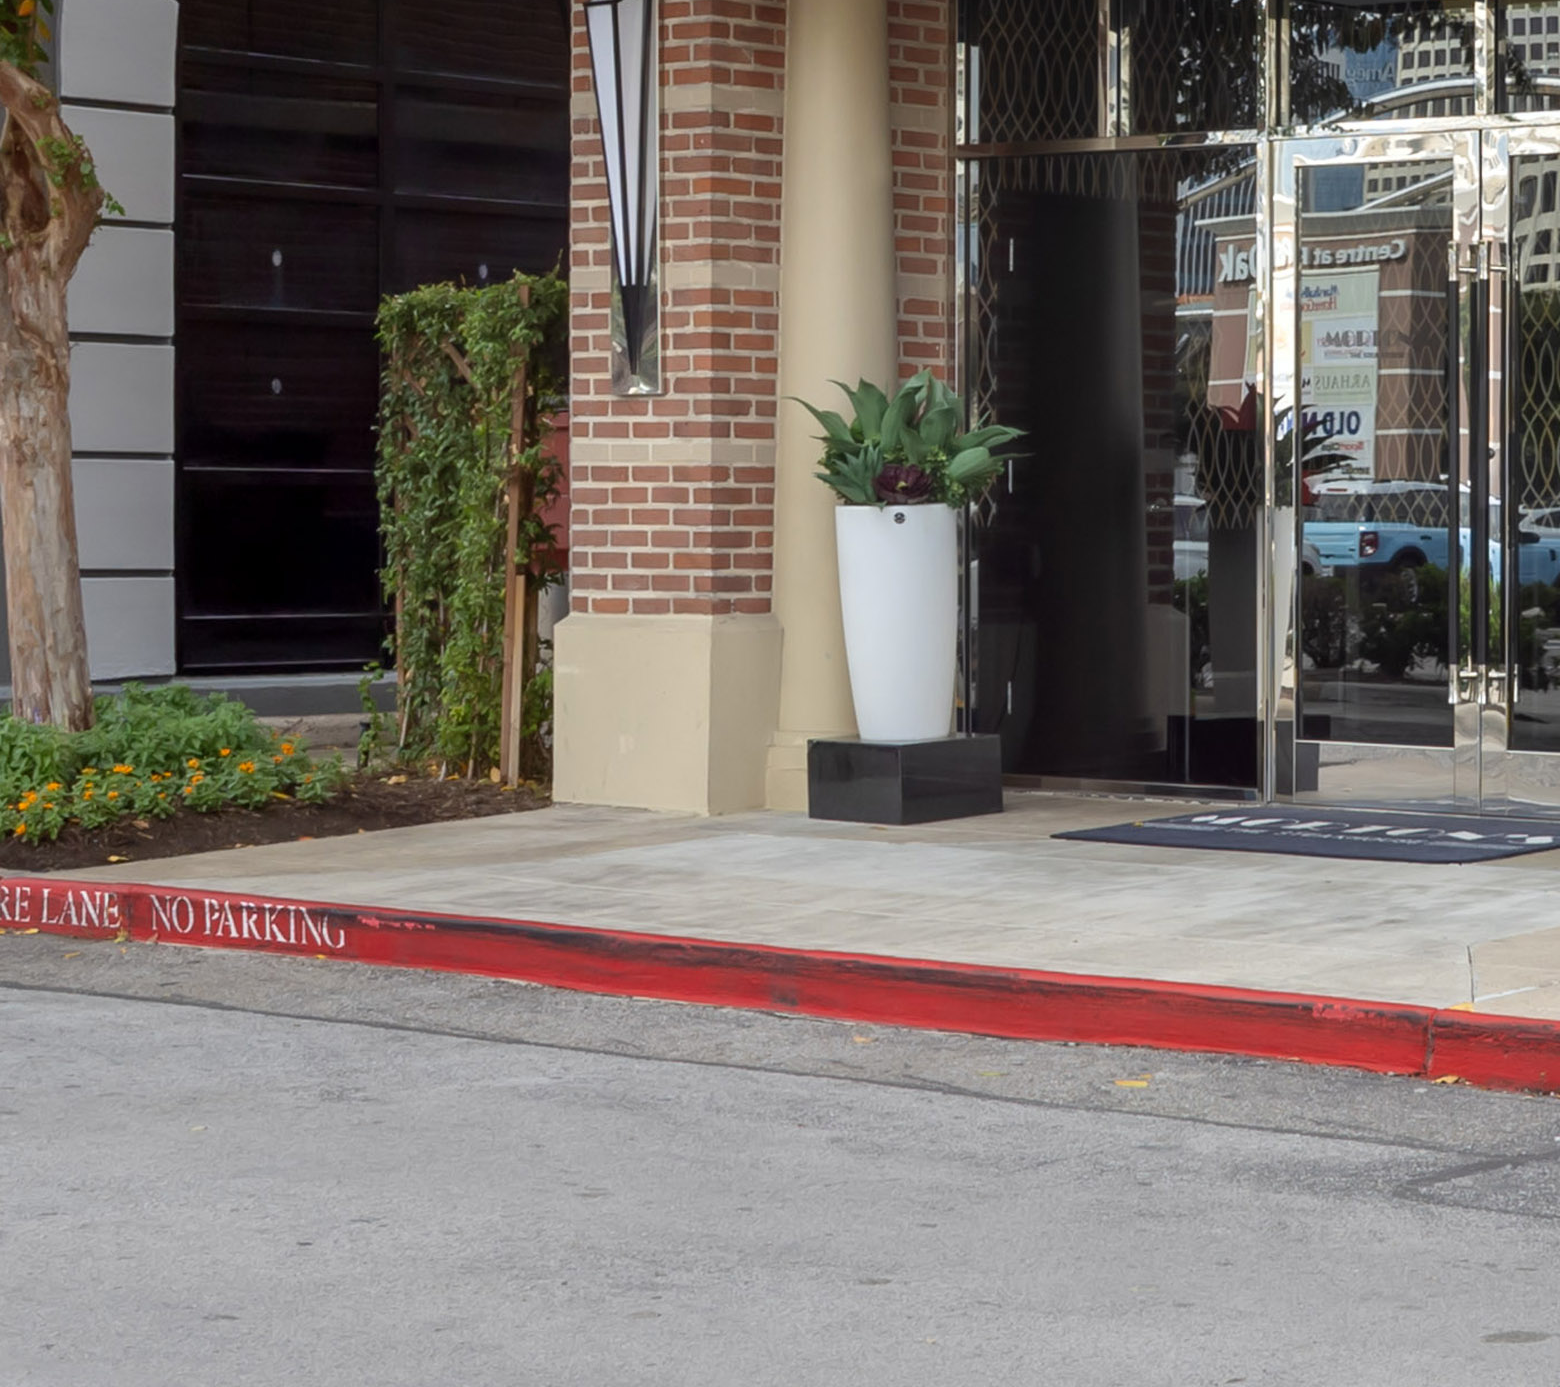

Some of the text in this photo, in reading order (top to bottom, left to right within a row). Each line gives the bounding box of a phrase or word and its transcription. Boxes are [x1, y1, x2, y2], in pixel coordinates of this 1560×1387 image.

[41, 887, 122, 929] LANE
[149, 894, 195, 934] NO
[204, 898, 346, 950] PARKING
